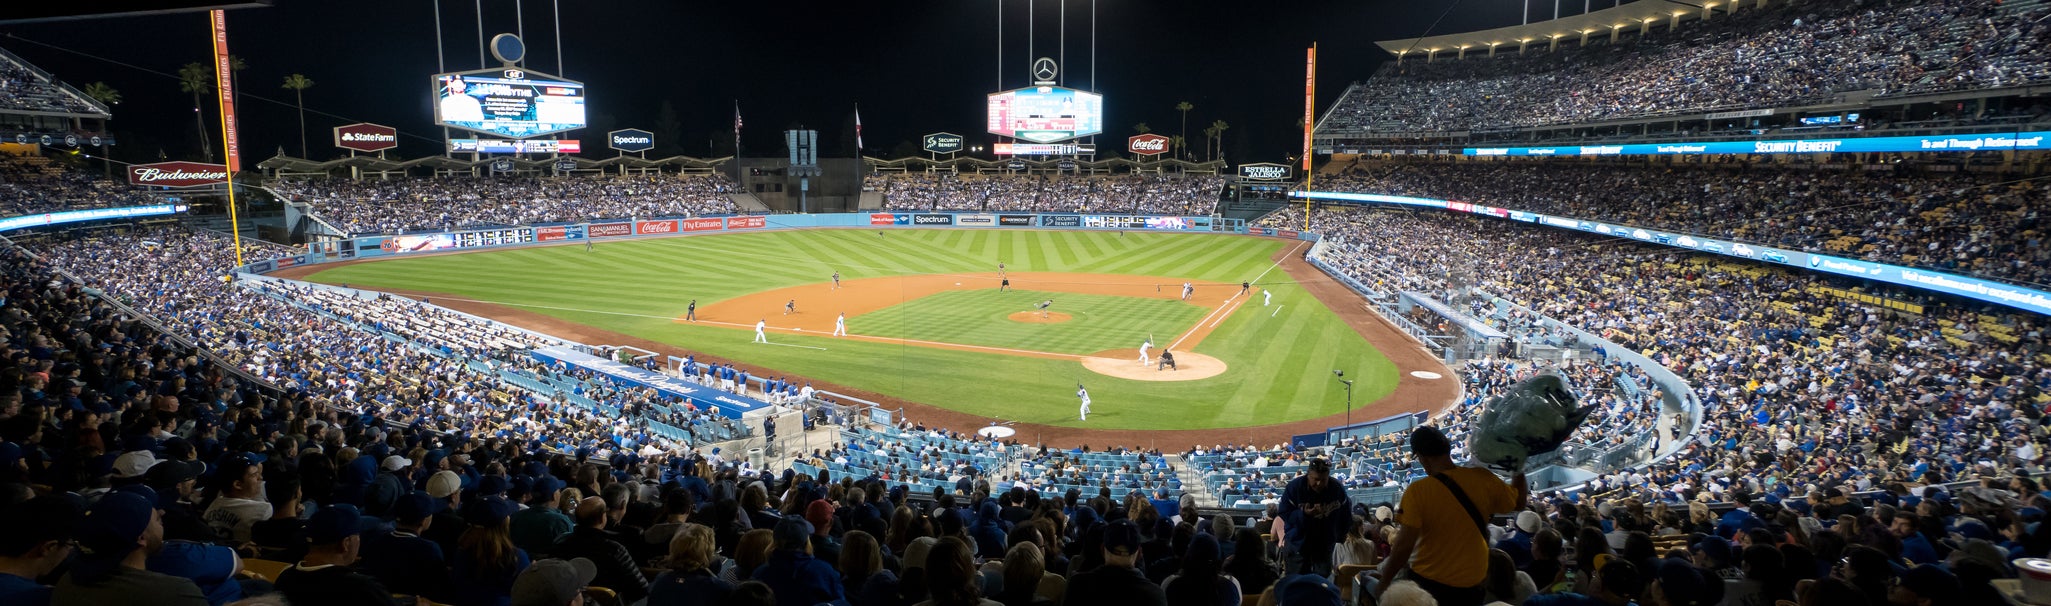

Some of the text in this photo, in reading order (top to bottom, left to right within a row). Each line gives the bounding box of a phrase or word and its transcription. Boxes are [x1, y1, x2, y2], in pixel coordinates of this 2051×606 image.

[354, 133, 375, 141] State
[614, 136, 648, 145] Spectrum
[1132, 138, 1166, 150] Coca-Cola
[1755, 141, 1796, 152] SECURITY
[135, 168, 226, 182] Budweiser
[642, 222, 672, 233] Coca-Cola
